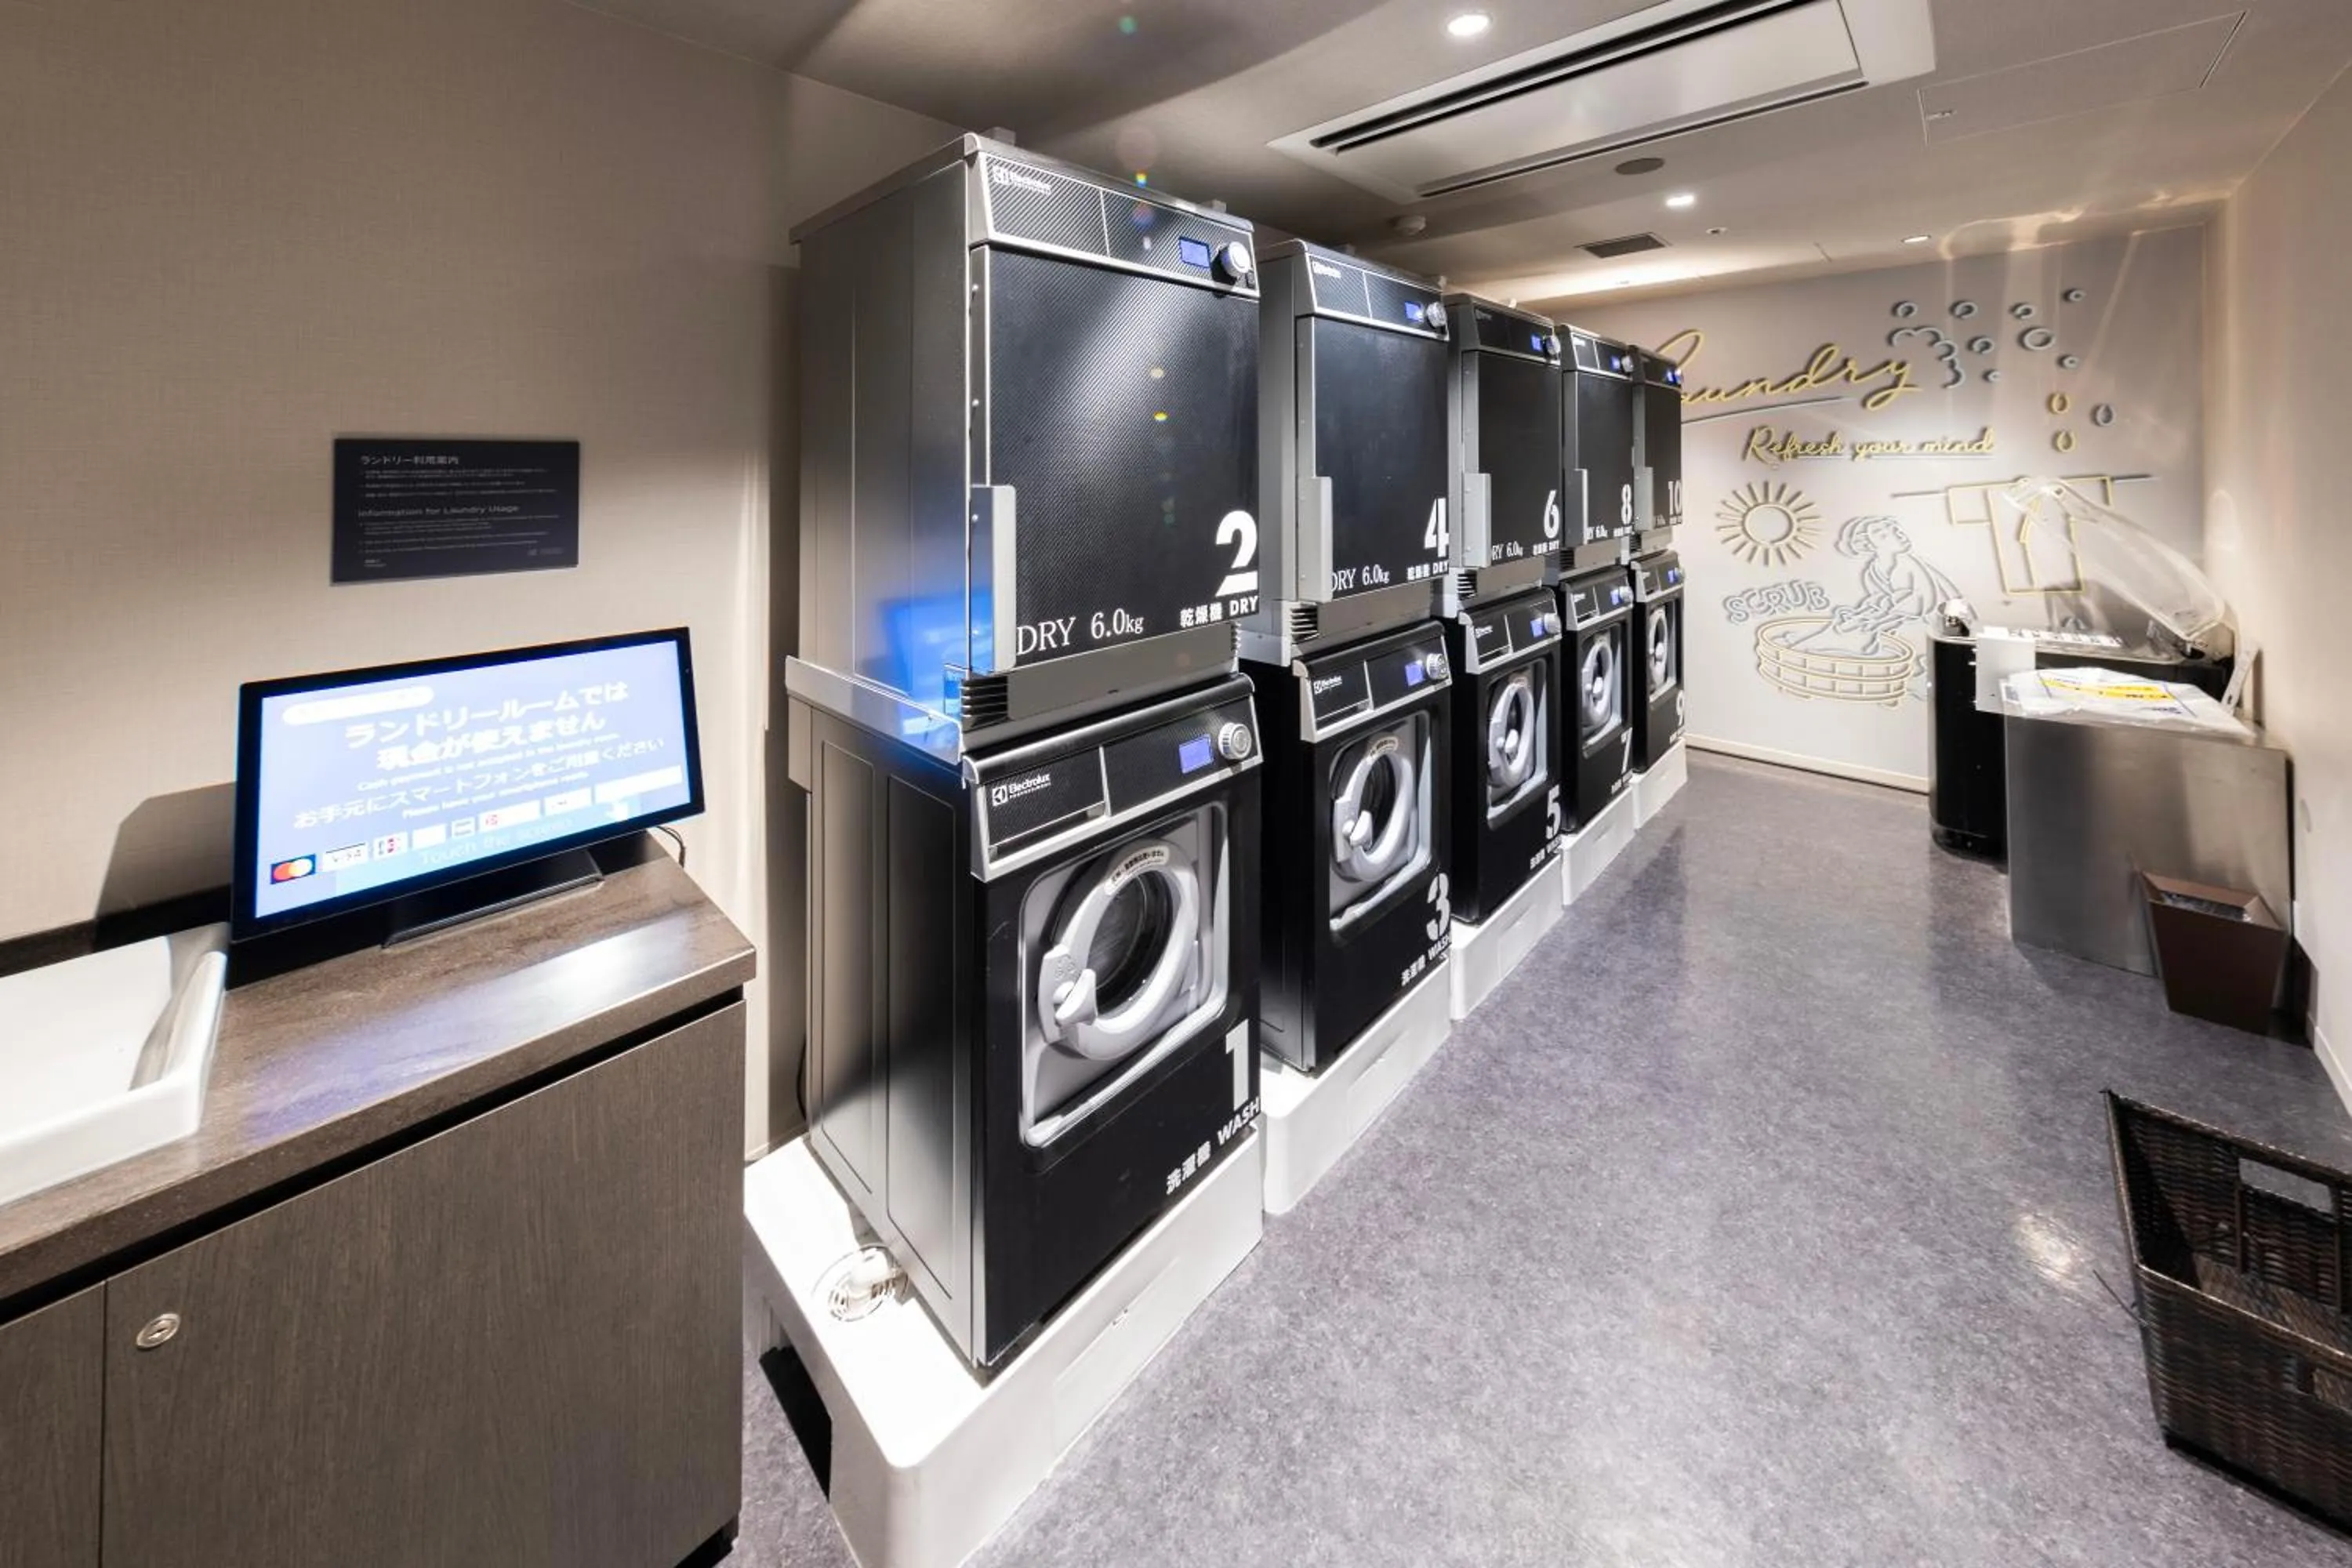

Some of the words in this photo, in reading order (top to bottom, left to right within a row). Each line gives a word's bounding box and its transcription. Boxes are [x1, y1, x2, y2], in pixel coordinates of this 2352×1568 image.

[1653, 329, 1922, 411] undry
[1745, 425, 1844, 470] Refresh
[1852, 440, 1913, 461] your
[1919, 426, 1994, 454] mind
[1544, 490, 1559, 539] 6
[1621, 484, 1632, 524] 8
[1668, 480, 1682, 515] 10
[1424, 497, 1450, 557] 4
[1216, 510, 1258, 597] 2
[1229, 596, 1258, 616] DRY
[1723, 579, 1830, 625] SCRUB
[1017, 616, 1076, 655] DRY
[1091, 608, 1144, 640] 6.0kg
[344, 679, 629, 751] ランドリールームでは
[1676, 690, 1684, 726] 9
[1621, 728, 1632, 774] 7
[1547, 785, 1560, 839] 5
[1426, 873, 1450, 941] 3
[1226, 1018, 1249, 1111] 1
[1218, 1097, 1259, 1145] WASH
